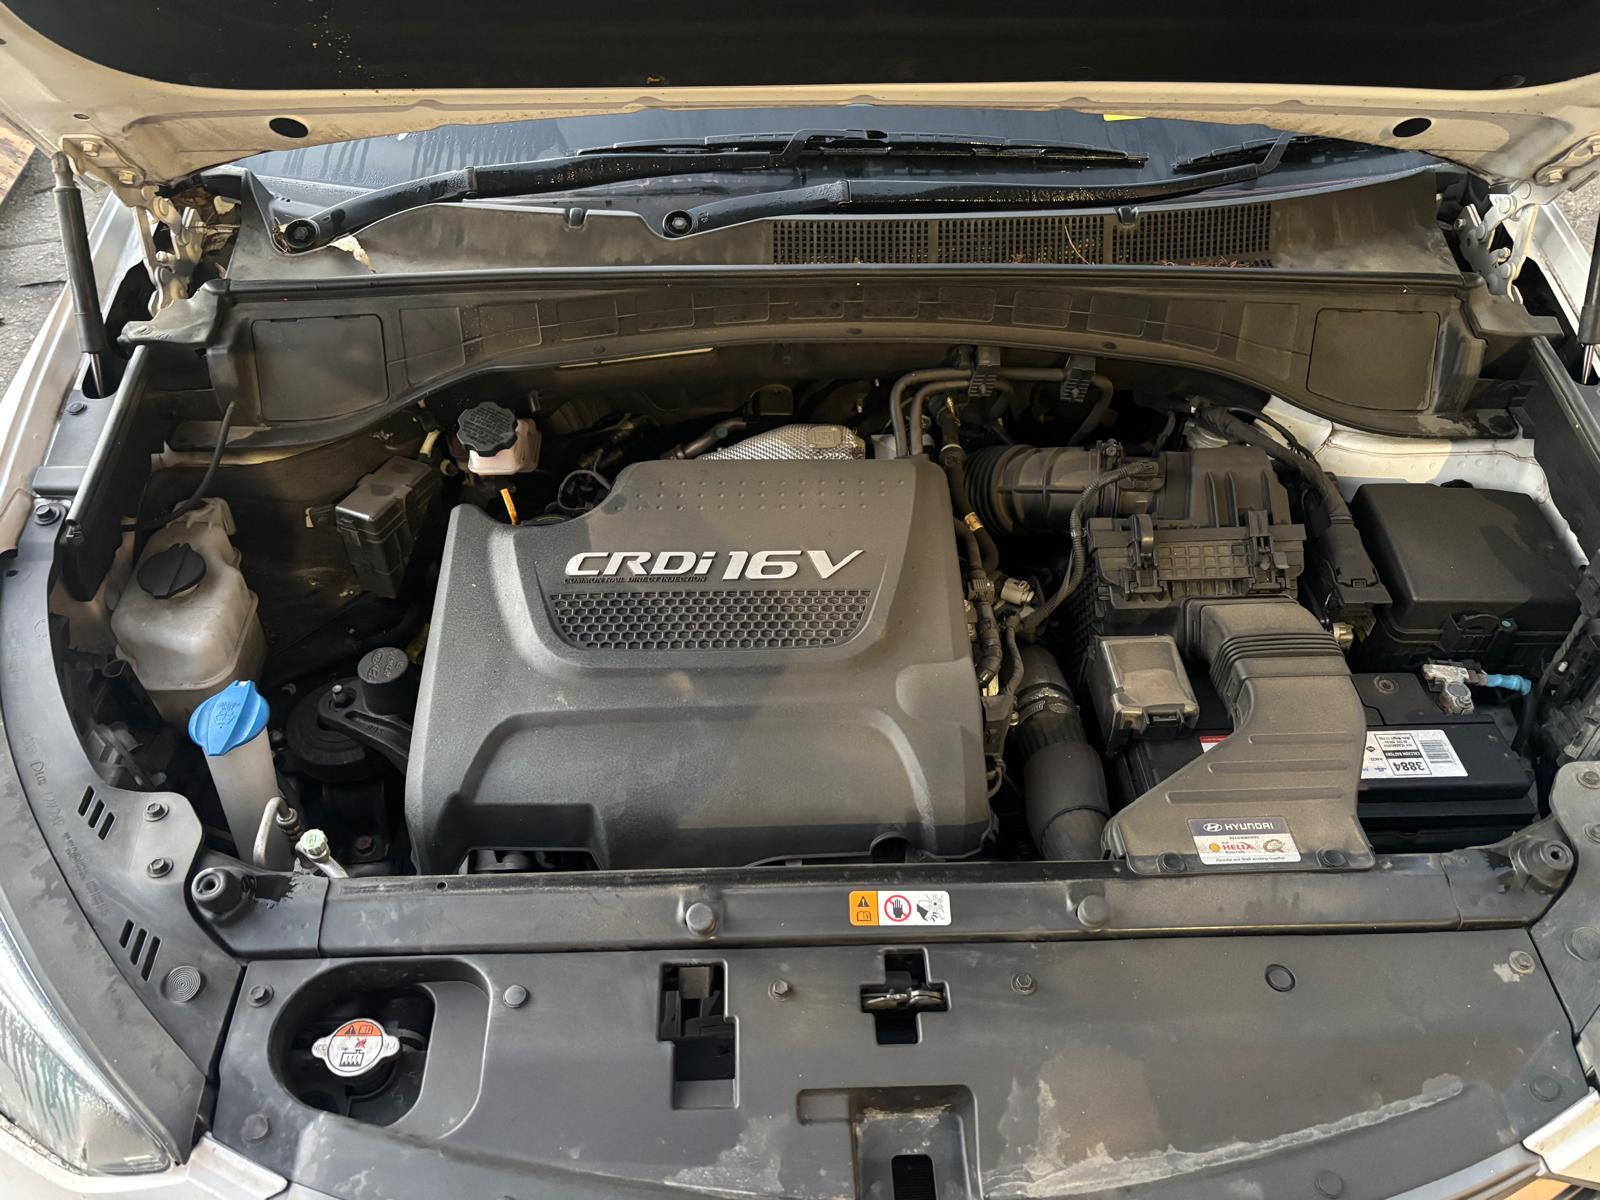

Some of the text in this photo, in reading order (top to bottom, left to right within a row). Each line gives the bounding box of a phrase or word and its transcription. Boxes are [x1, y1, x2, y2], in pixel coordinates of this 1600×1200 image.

[565, 551, 717, 576] CRDi
[1392, 761, 1425, 771] 3884
[1224, 822, 1274, 831] HYUNDAI
[1222, 843, 1256, 851] HELIX
